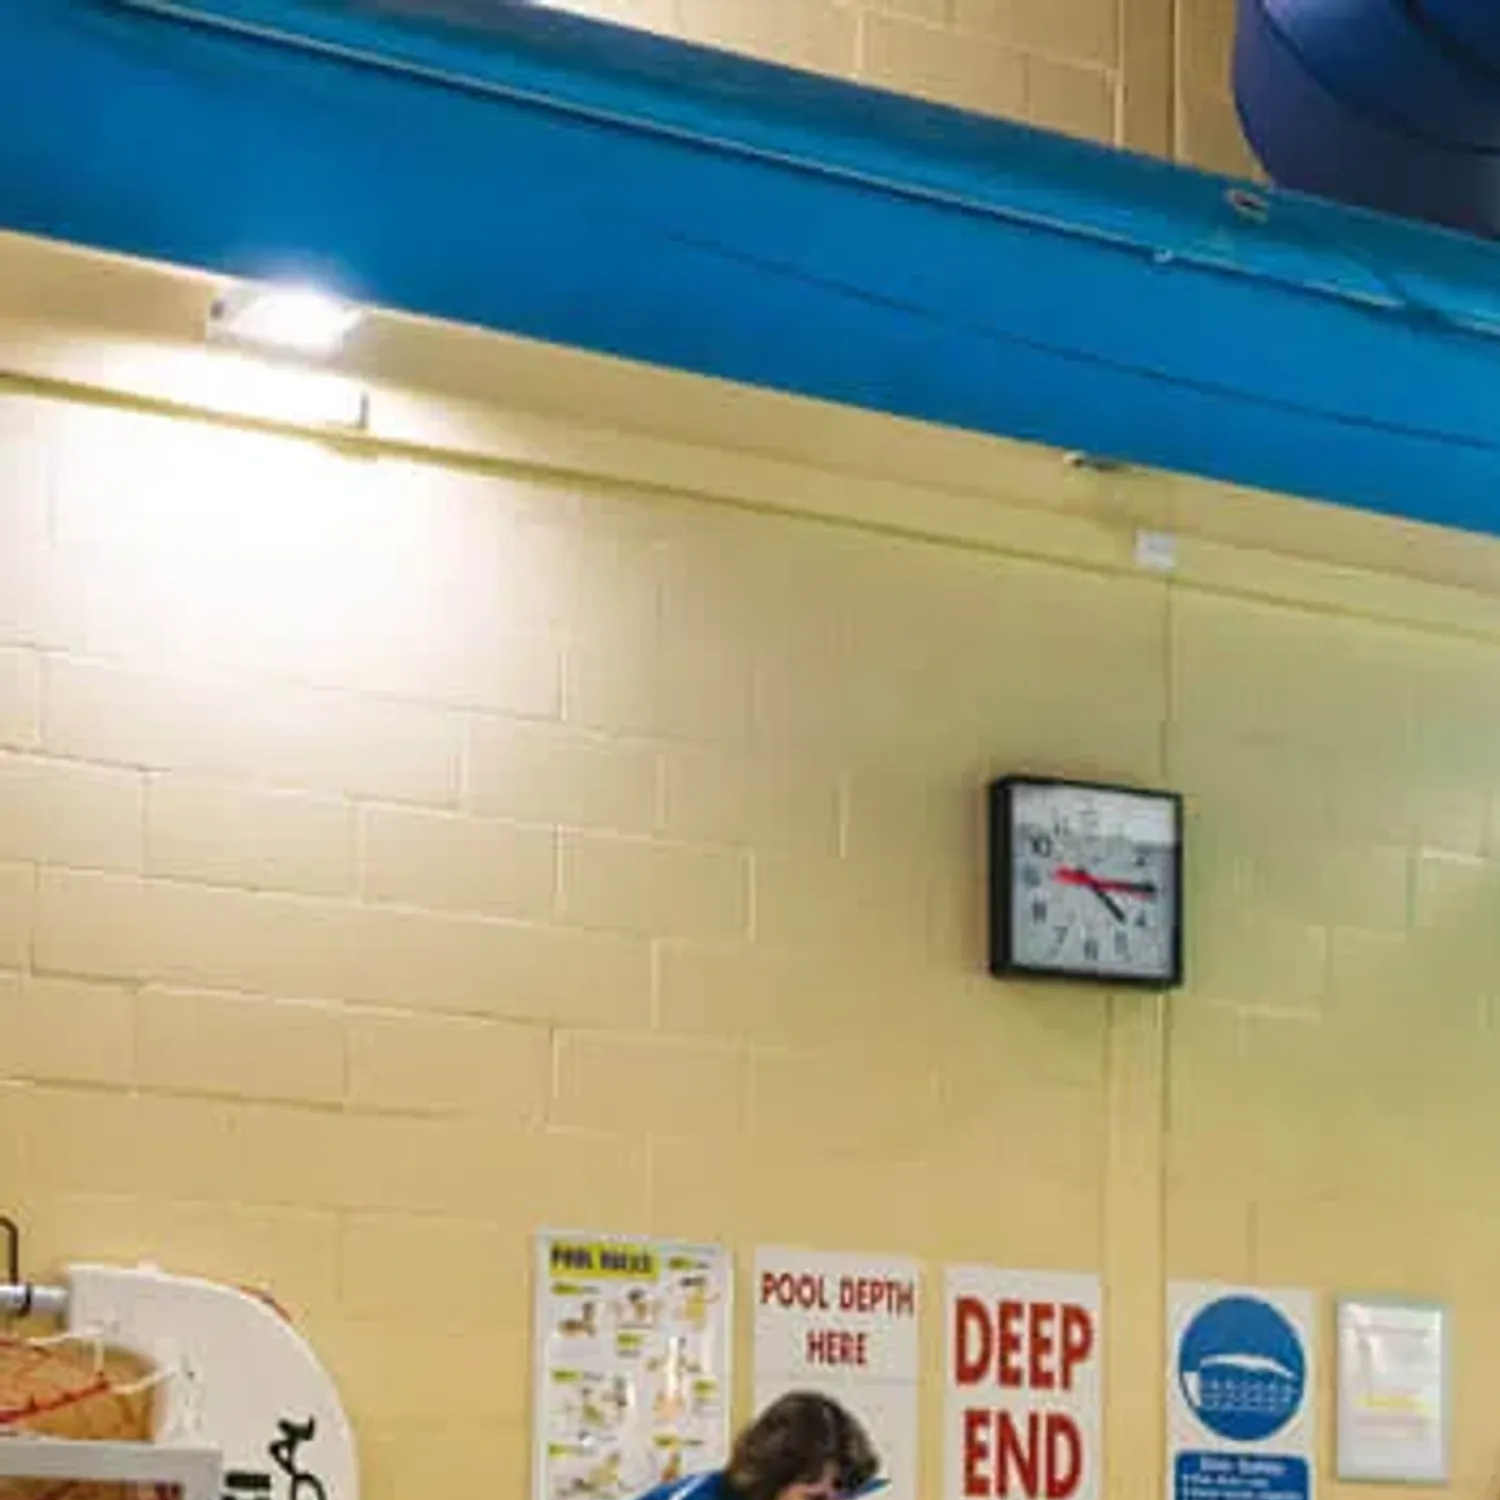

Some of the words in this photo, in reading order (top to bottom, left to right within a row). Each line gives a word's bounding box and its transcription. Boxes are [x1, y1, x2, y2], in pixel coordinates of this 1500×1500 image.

[1030, 833, 1051, 858] 10
[761, 1271, 829, 1310] POOL
[839, 1275, 915, 1319] DEPTH
[806, 1330, 868, 1367] HERE
[955, 1295, 1095, 1391] DEEP
